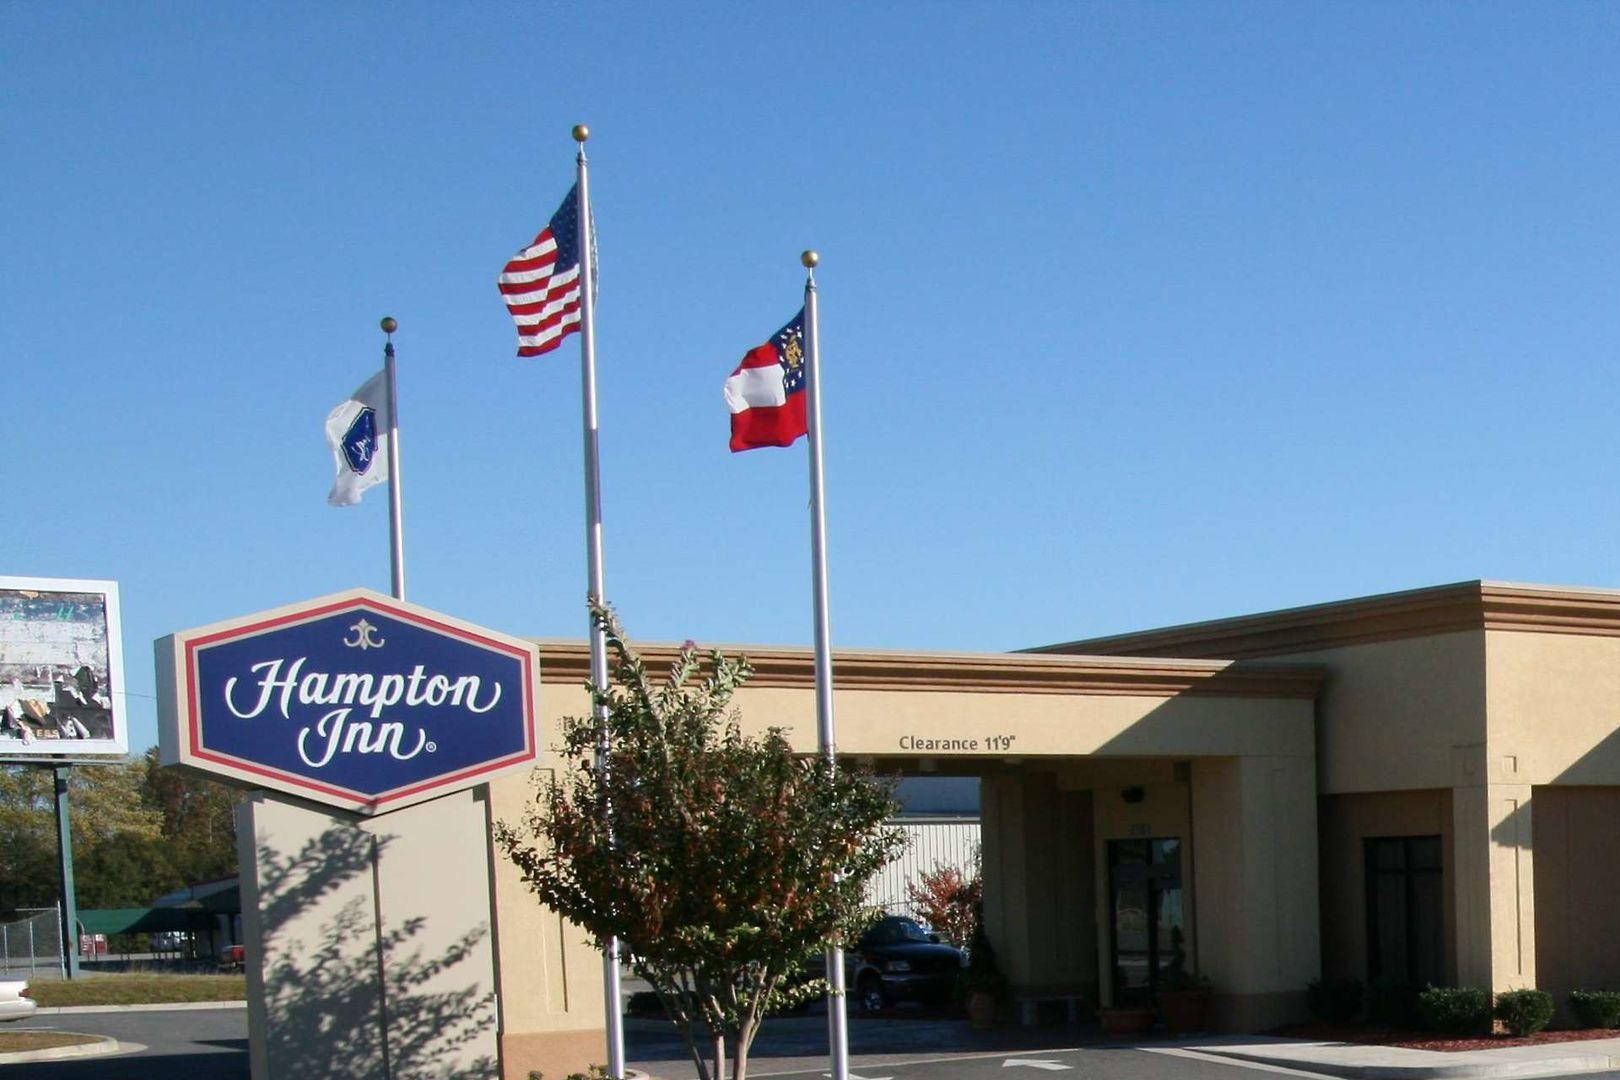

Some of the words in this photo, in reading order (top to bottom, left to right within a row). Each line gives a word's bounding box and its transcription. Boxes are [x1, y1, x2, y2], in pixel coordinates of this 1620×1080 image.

[225, 656, 502, 719] Hampton
[298, 708, 426, 768] Inn
[899, 736, 978, 750] Clearance
[984, 735, 1016, 750] 11'9"
